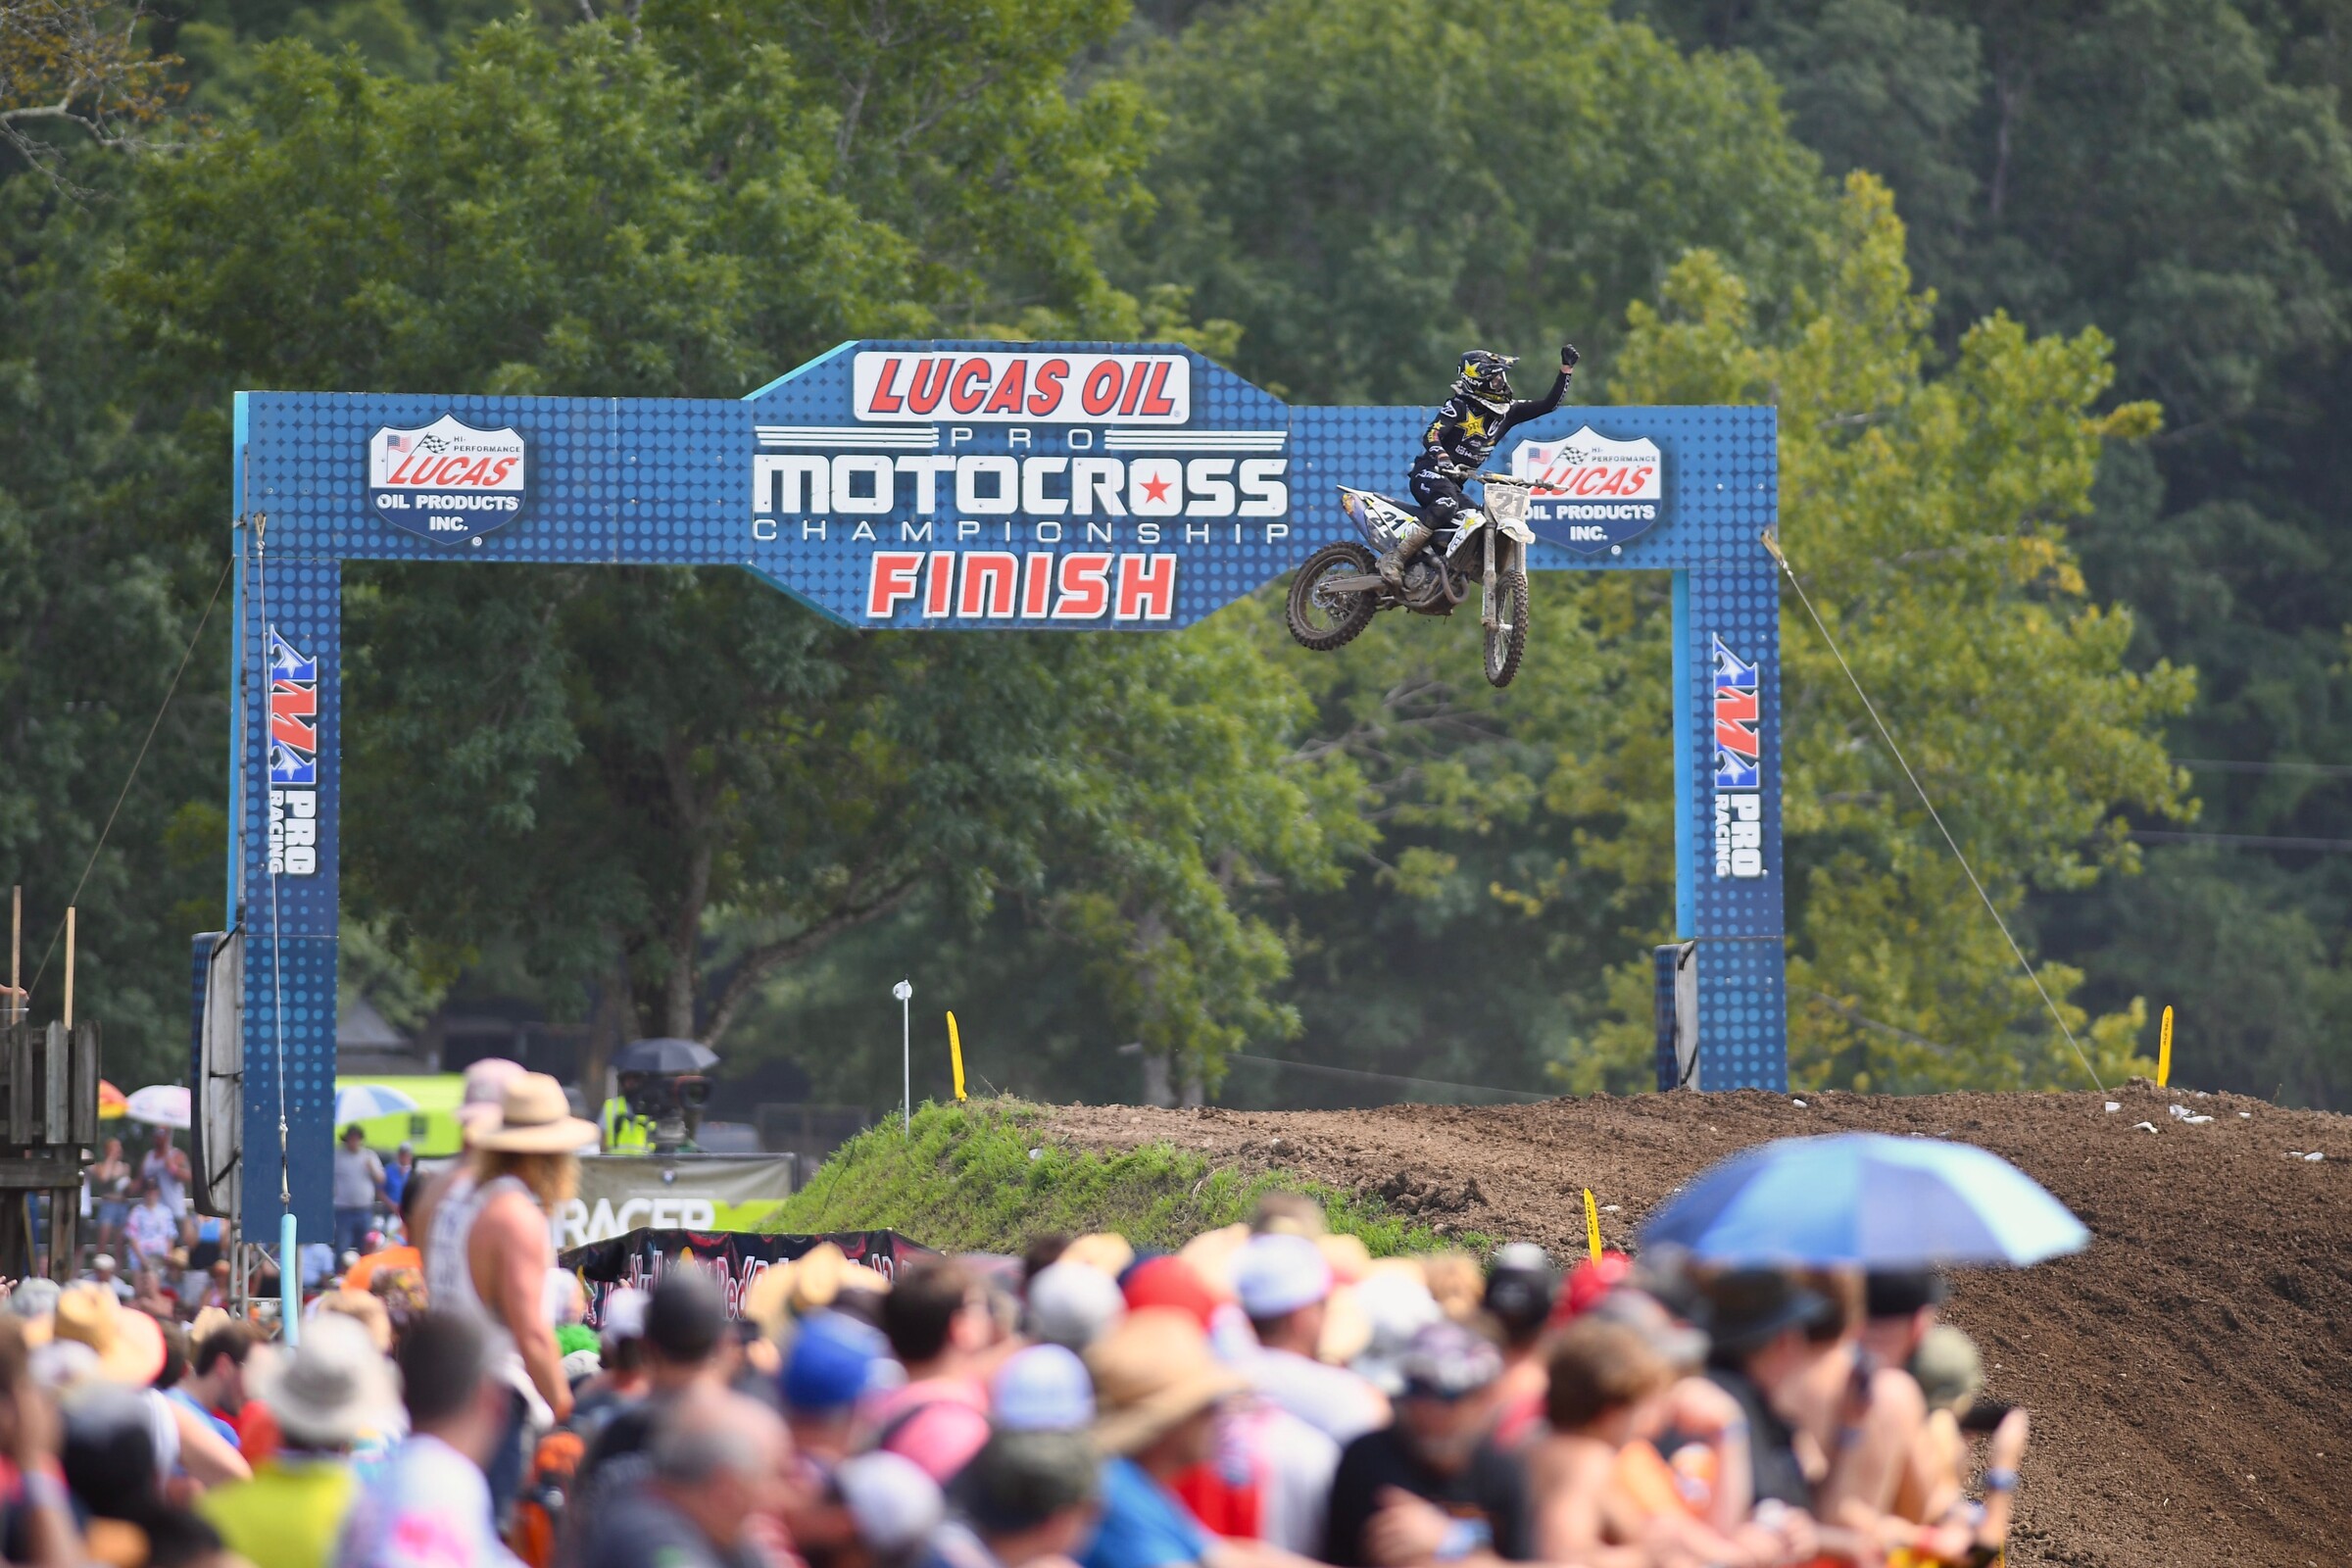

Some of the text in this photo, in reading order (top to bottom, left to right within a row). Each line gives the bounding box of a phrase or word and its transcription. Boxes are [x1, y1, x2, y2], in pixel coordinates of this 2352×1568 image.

[868, 358, 1176, 417] LUCAS OIL
[453, 445, 521, 454] PERFORMANCE
[950, 426, 1094, 450] PRO
[387, 455, 518, 487] LUCAS
[1591, 455, 1657, 464] PERFORMANCE
[376, 493, 520, 511] OIL PRODUCTS
[753, 454, 1290, 518] MOTOCROSS
[1494, 492, 1526, 517] 21
[1524, 504, 1656, 520] OIL PRODUCTS
[428, 515, 469, 531] INC.
[752, 517, 1290, 545] CHAMPIONSHIP
[1569, 525, 1608, 541] INC.
[865, 550, 1178, 622] FINISH
[270, 623, 318, 784] AMA
[1712, 631, 1760, 790] AMA
[269, 790, 284, 874] RACING
[285, 790, 317, 875] PRO
[1714, 793, 1731, 878] RACING
[1730, 793, 1762, 878] PRO
